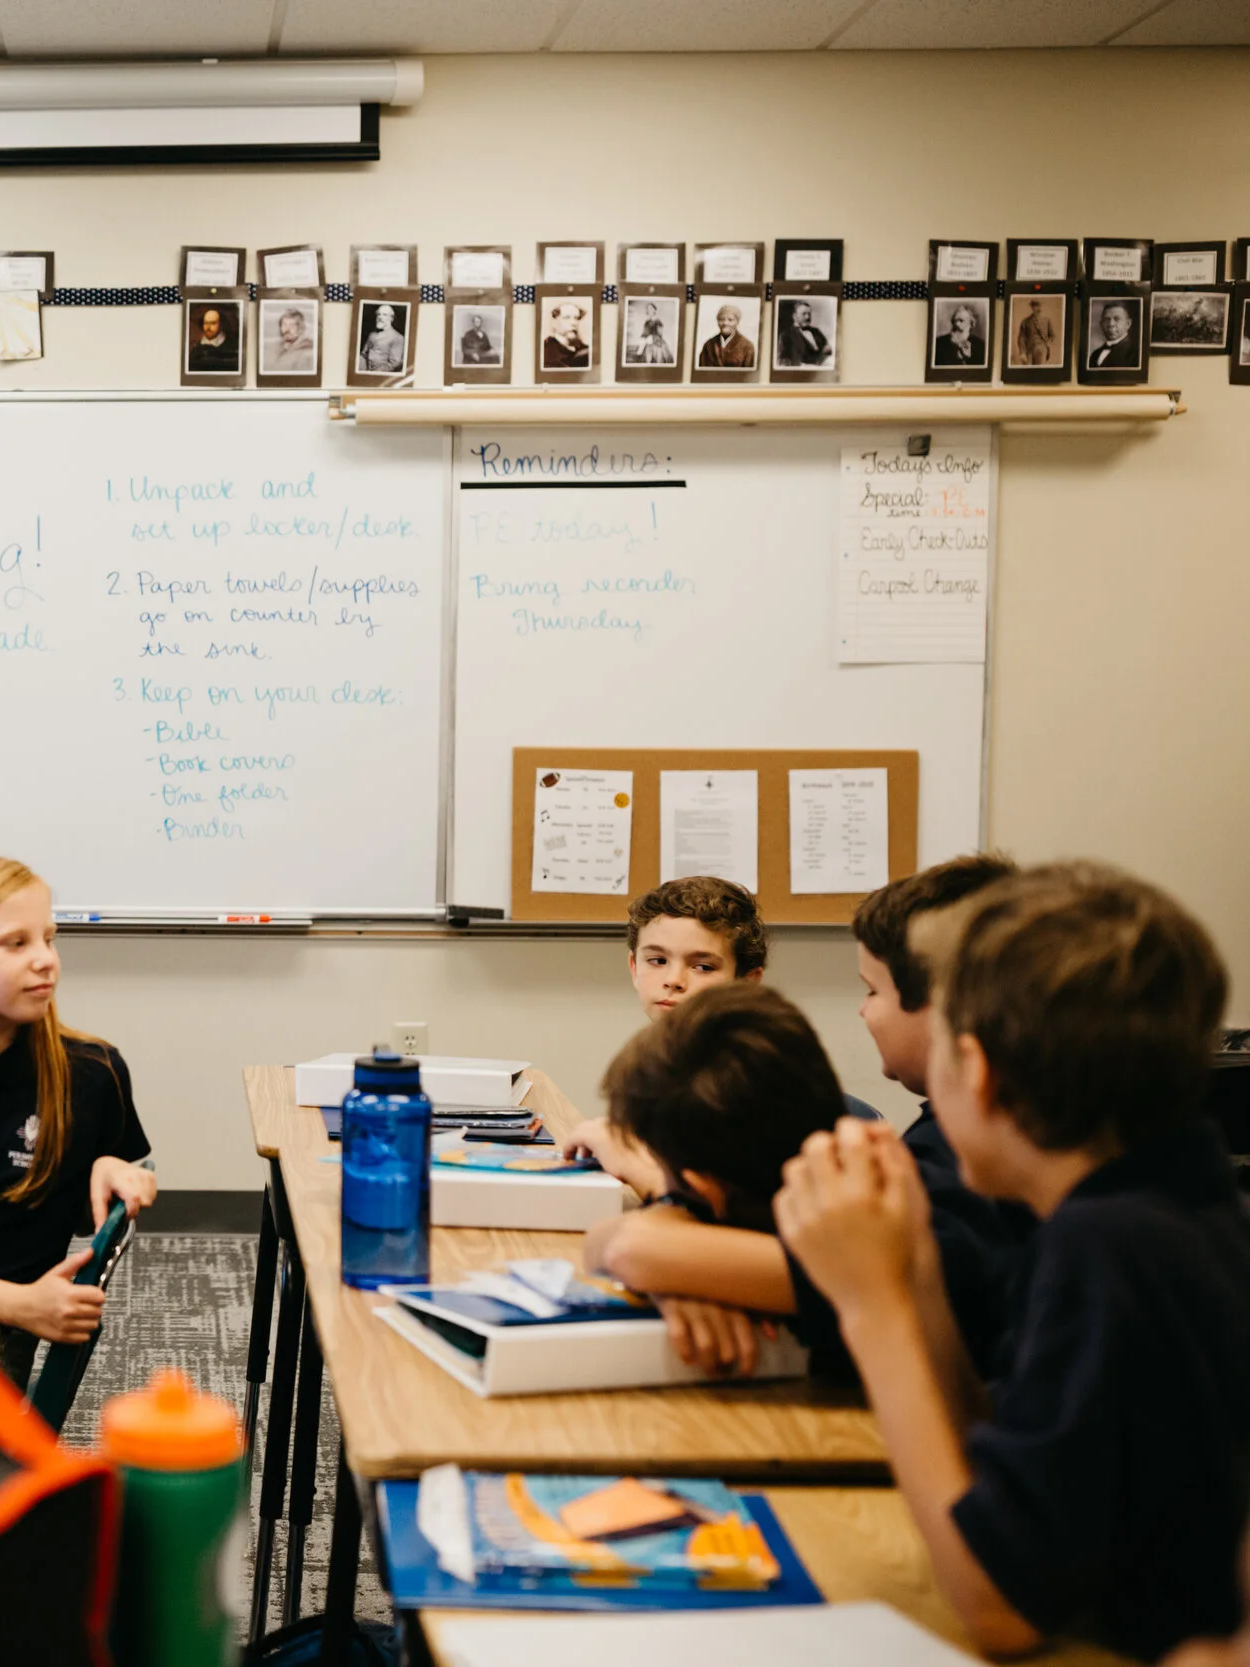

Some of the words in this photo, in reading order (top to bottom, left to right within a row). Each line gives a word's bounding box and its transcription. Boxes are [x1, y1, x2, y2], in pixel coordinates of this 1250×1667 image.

[470, 442, 672, 477] Reminders:
[861, 451, 932, 483] Today's
[130, 476, 236, 513] Unpack
[261, 471, 319, 500] and
[130, 519, 175, 540] set
[192, 519, 231, 547] up
[861, 526, 904, 561] Early
[137, 571, 212, 604] Paper
[470, 573, 562, 606] Bring
[581, 569, 698, 594] recorder
[923, 569, 981, 603] Change
[139, 610, 166, 636] go
[184, 610, 213, 623] on
[230, 607, 318, 626] counter
[335, 607, 382, 637] by
[511, 609, 652, 643] Thursday
[139, 640, 186, 658] the
[141, 677, 193, 714] Keep
[208, 684, 245, 706] on
[255, 685, 320, 721] your
[220, 754, 296, 773] covers
[218, 782, 288, 813] folder
